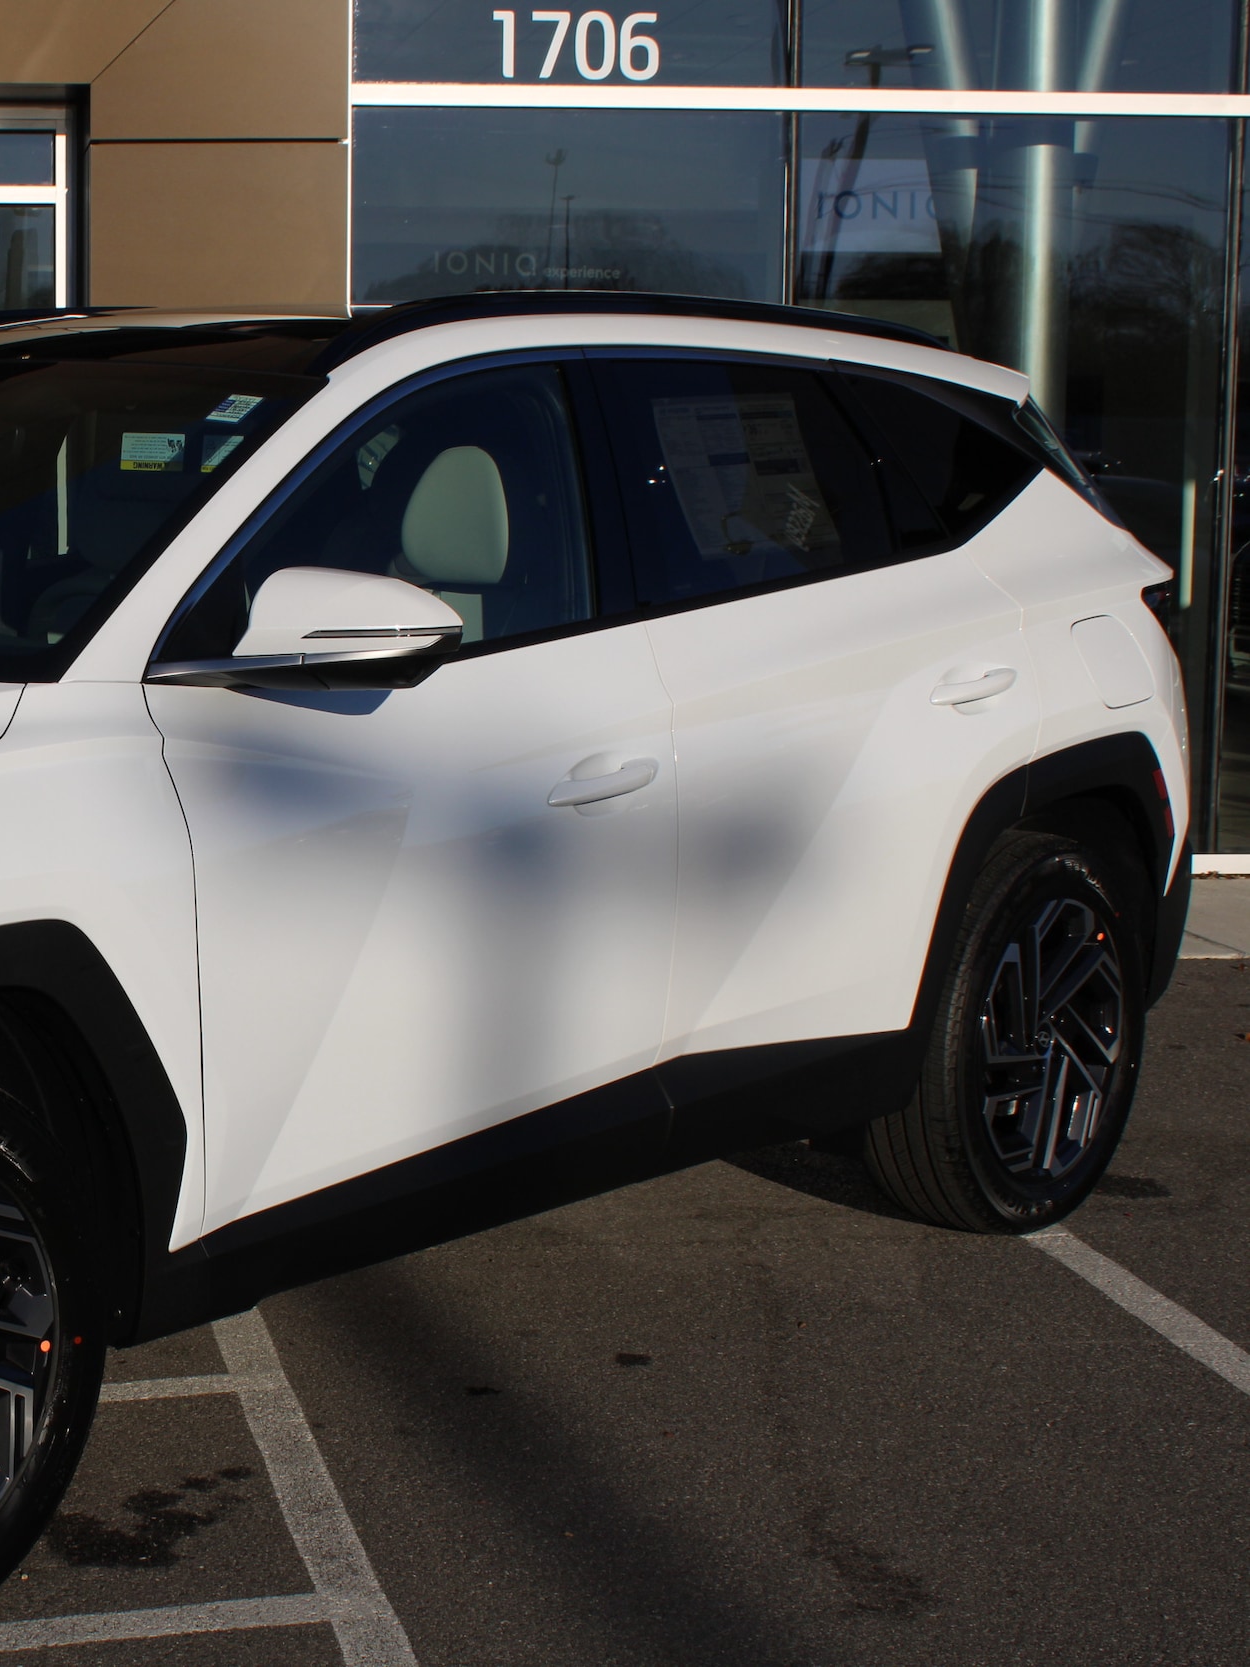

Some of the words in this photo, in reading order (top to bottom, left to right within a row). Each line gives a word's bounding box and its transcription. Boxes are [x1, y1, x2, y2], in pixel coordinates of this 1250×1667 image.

[493, 10, 660, 81] 1706
[434, 251, 537, 277] IONIQ
[543, 265, 621, 280] experience
[132, 461, 163, 470] WARNING
